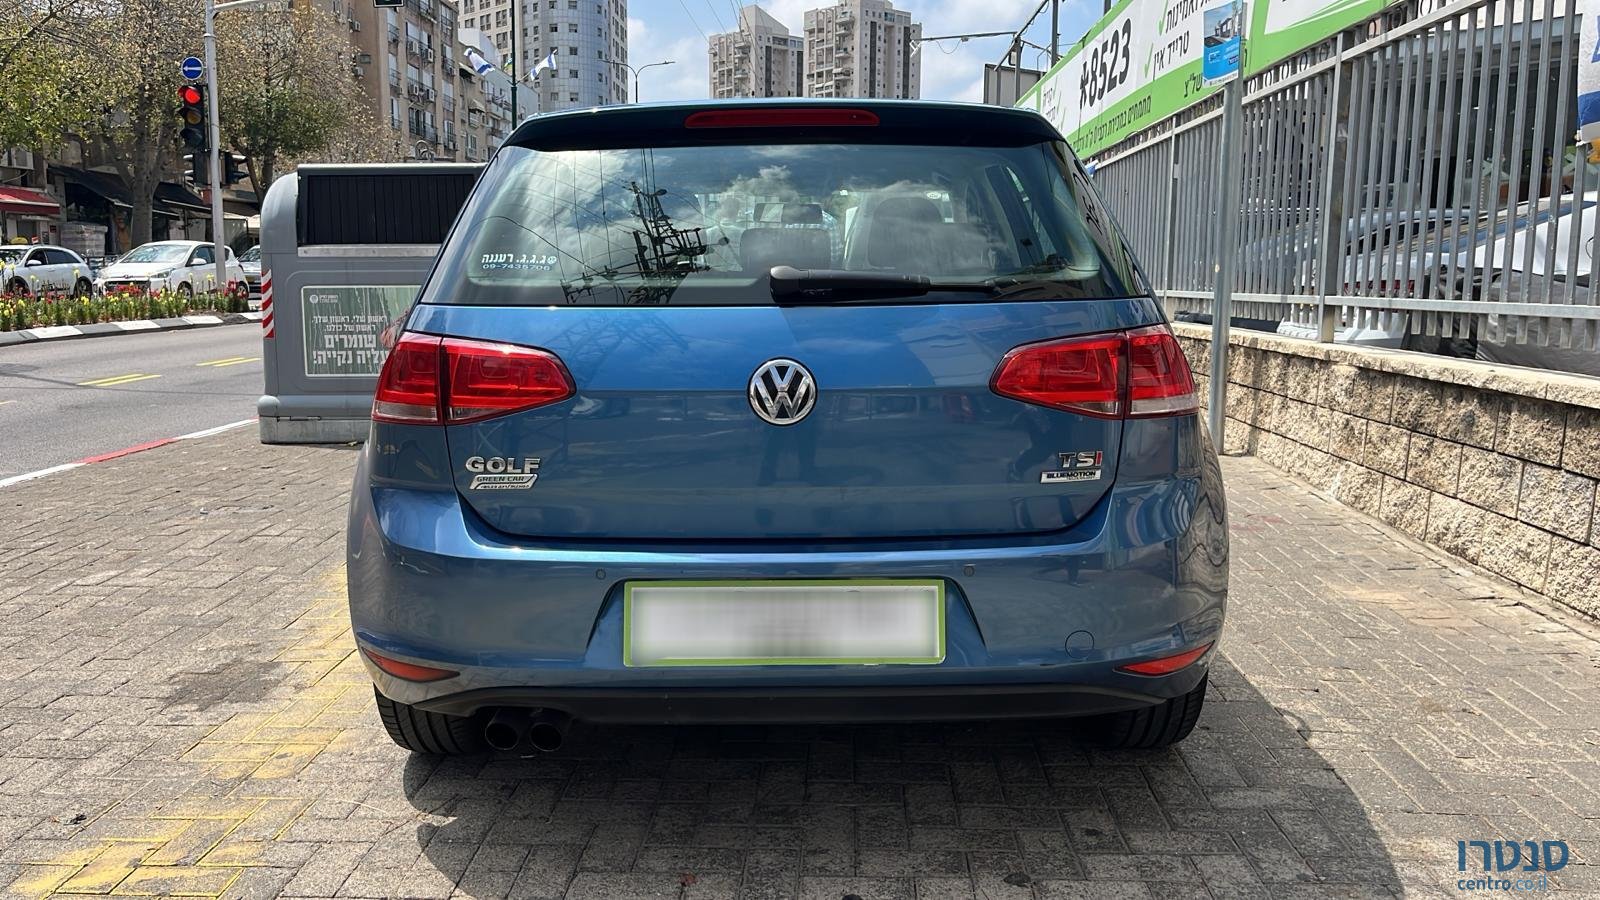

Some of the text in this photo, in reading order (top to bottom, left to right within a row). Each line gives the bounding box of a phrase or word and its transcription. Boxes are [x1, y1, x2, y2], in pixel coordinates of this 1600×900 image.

[1168, 30, 1189, 64] טרייד
[1153, 47, 1165, 80] אין
[481, 253, 514, 263] רעננה
[329, 315, 350, 324] ראשון
[356, 324, 376, 332] ראשון
[324, 334, 376, 348] שומרים
[313, 350, 352, 366] נקייה!
[465, 456, 541, 473] GOLF
[1059, 451, 1103, 467] TSI
[1046, 471, 1096, 479] BLUEMOTION
